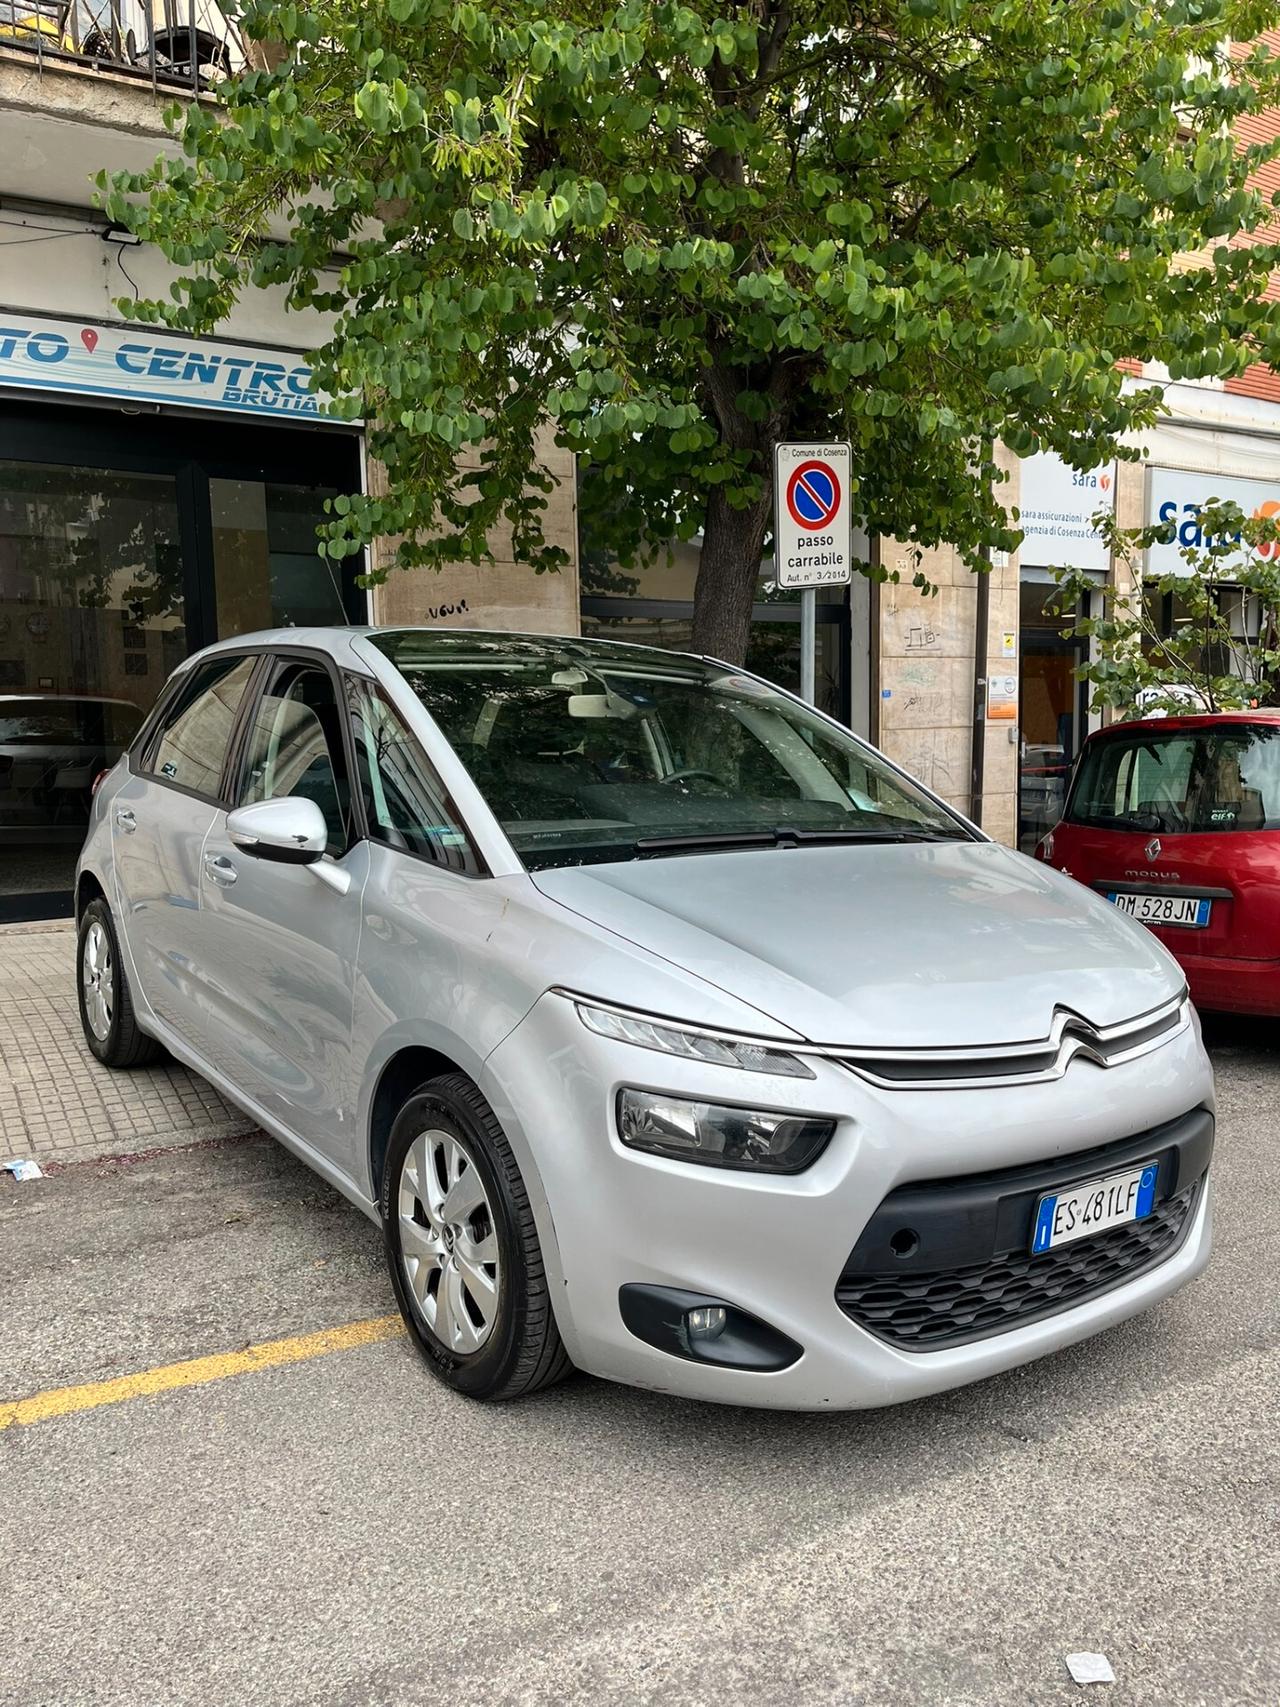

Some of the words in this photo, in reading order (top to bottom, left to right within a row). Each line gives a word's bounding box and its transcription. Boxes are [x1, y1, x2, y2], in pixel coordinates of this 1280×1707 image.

[222, 386, 318, 412] BRUTIA
[791, 448, 816, 458] Comune
[816, 448, 823, 457] di
[823, 448, 848, 457] Cosenza
[1072, 473, 1097, 488] sara
[1021, 510, 1036, 519] sara
[1037, 511, 1082, 523] assicurazioni
[1049, 525, 1056, 536] di
[1057, 527, 1085, 538] Cosenza
[797, 535, 834, 550] passo
[787, 552, 843, 568] carrabile
[787, 573, 802, 583] Aut.
